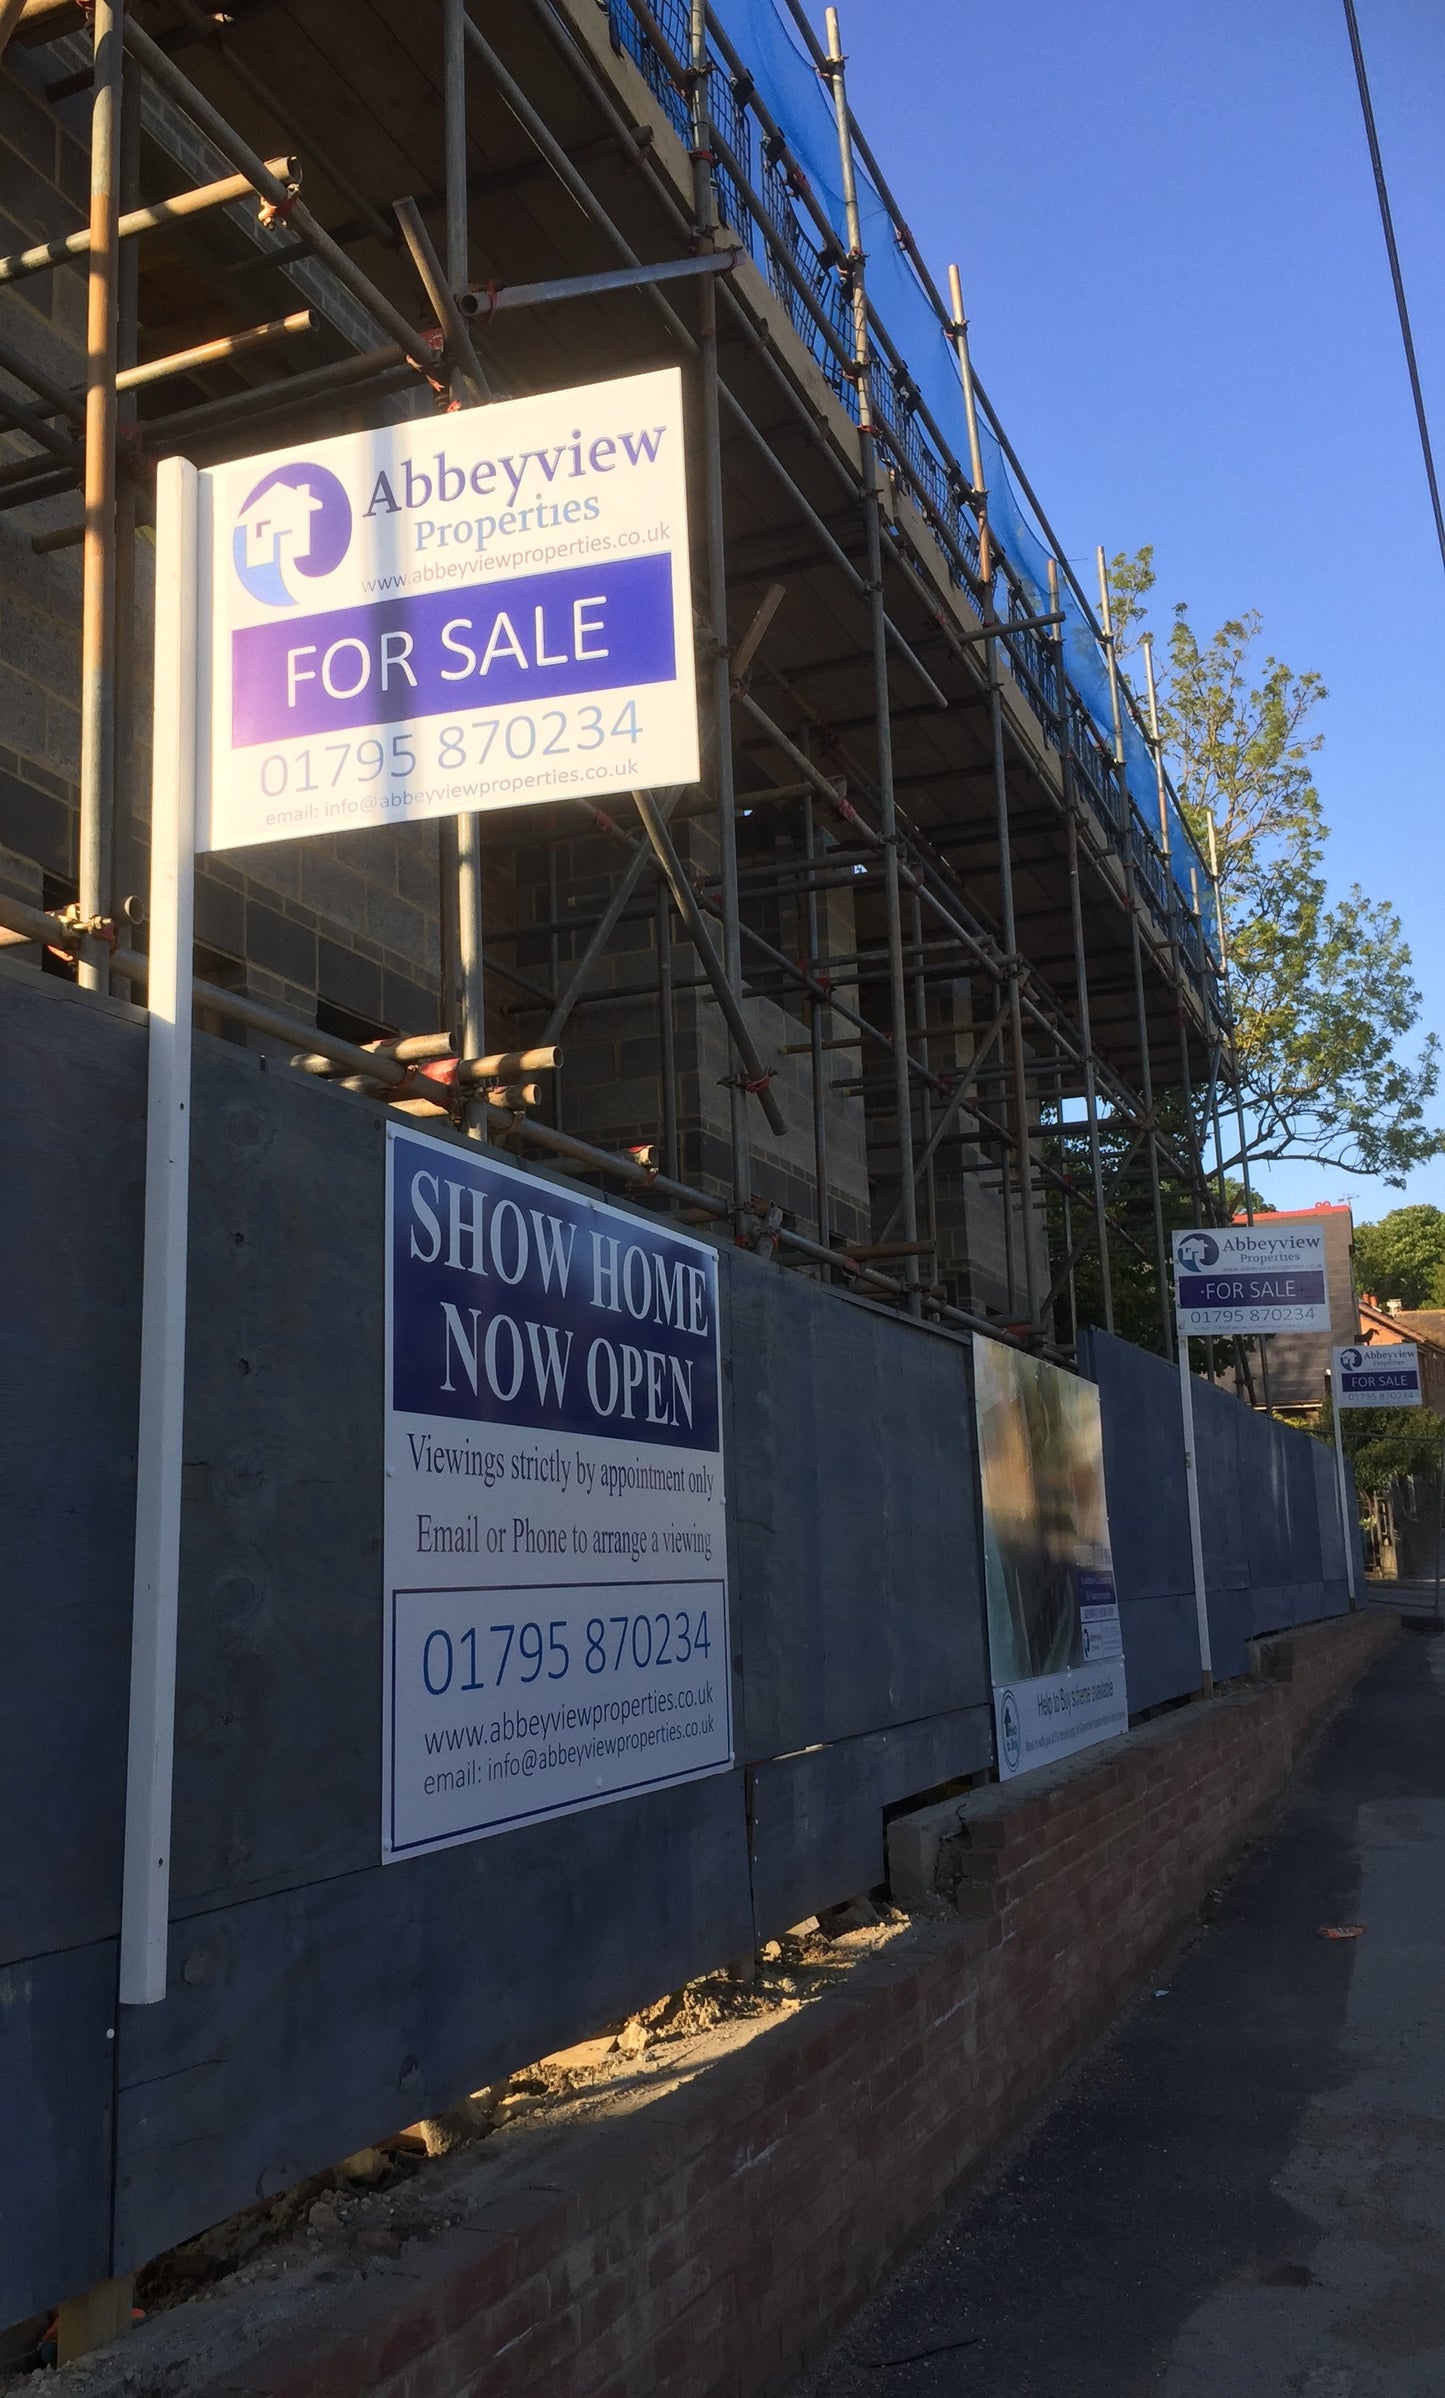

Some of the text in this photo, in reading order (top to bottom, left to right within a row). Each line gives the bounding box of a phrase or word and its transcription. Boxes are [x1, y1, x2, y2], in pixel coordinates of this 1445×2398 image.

[363, 425, 667, 517] Abbeyview
[361, 522, 671, 593] www.abbeyviewproperties.co.uk
[414, 495, 600, 552] Properties
[287, 595, 609, 708] FOR SALE
[260, 699, 644, 798] 01795 870234
[265, 758, 639, 826] email: info@abbeyviewproperties.co.uk
[410, 1169, 708, 1337] SHOW HOME
[1223, 1235, 1321, 1254] Abbeyview
[1240, 1252, 1300, 1265] Properties
[1191, 1306, 1316, 1324] 01795 870234
[1206, 1279, 1296, 1300] FOR SALE
[440, 1301, 694, 1430] NOW OPEN
[1352, 1375, 1408, 1388] FOR SALE
[1364, 1350, 1415, 1361] Abbeyview
[407, 1433, 714, 1502] Viewings strictly by appointment only
[416, 1514, 711, 1562] Email or Phone to arrange a viewing
[423, 1610, 712, 1696] 01795 870234
[424, 1680, 714, 1755] www.abbeyviewproperties.co.uk
[424, 1714, 715, 1795] email: info@abbeyviewproperties.co.uk
